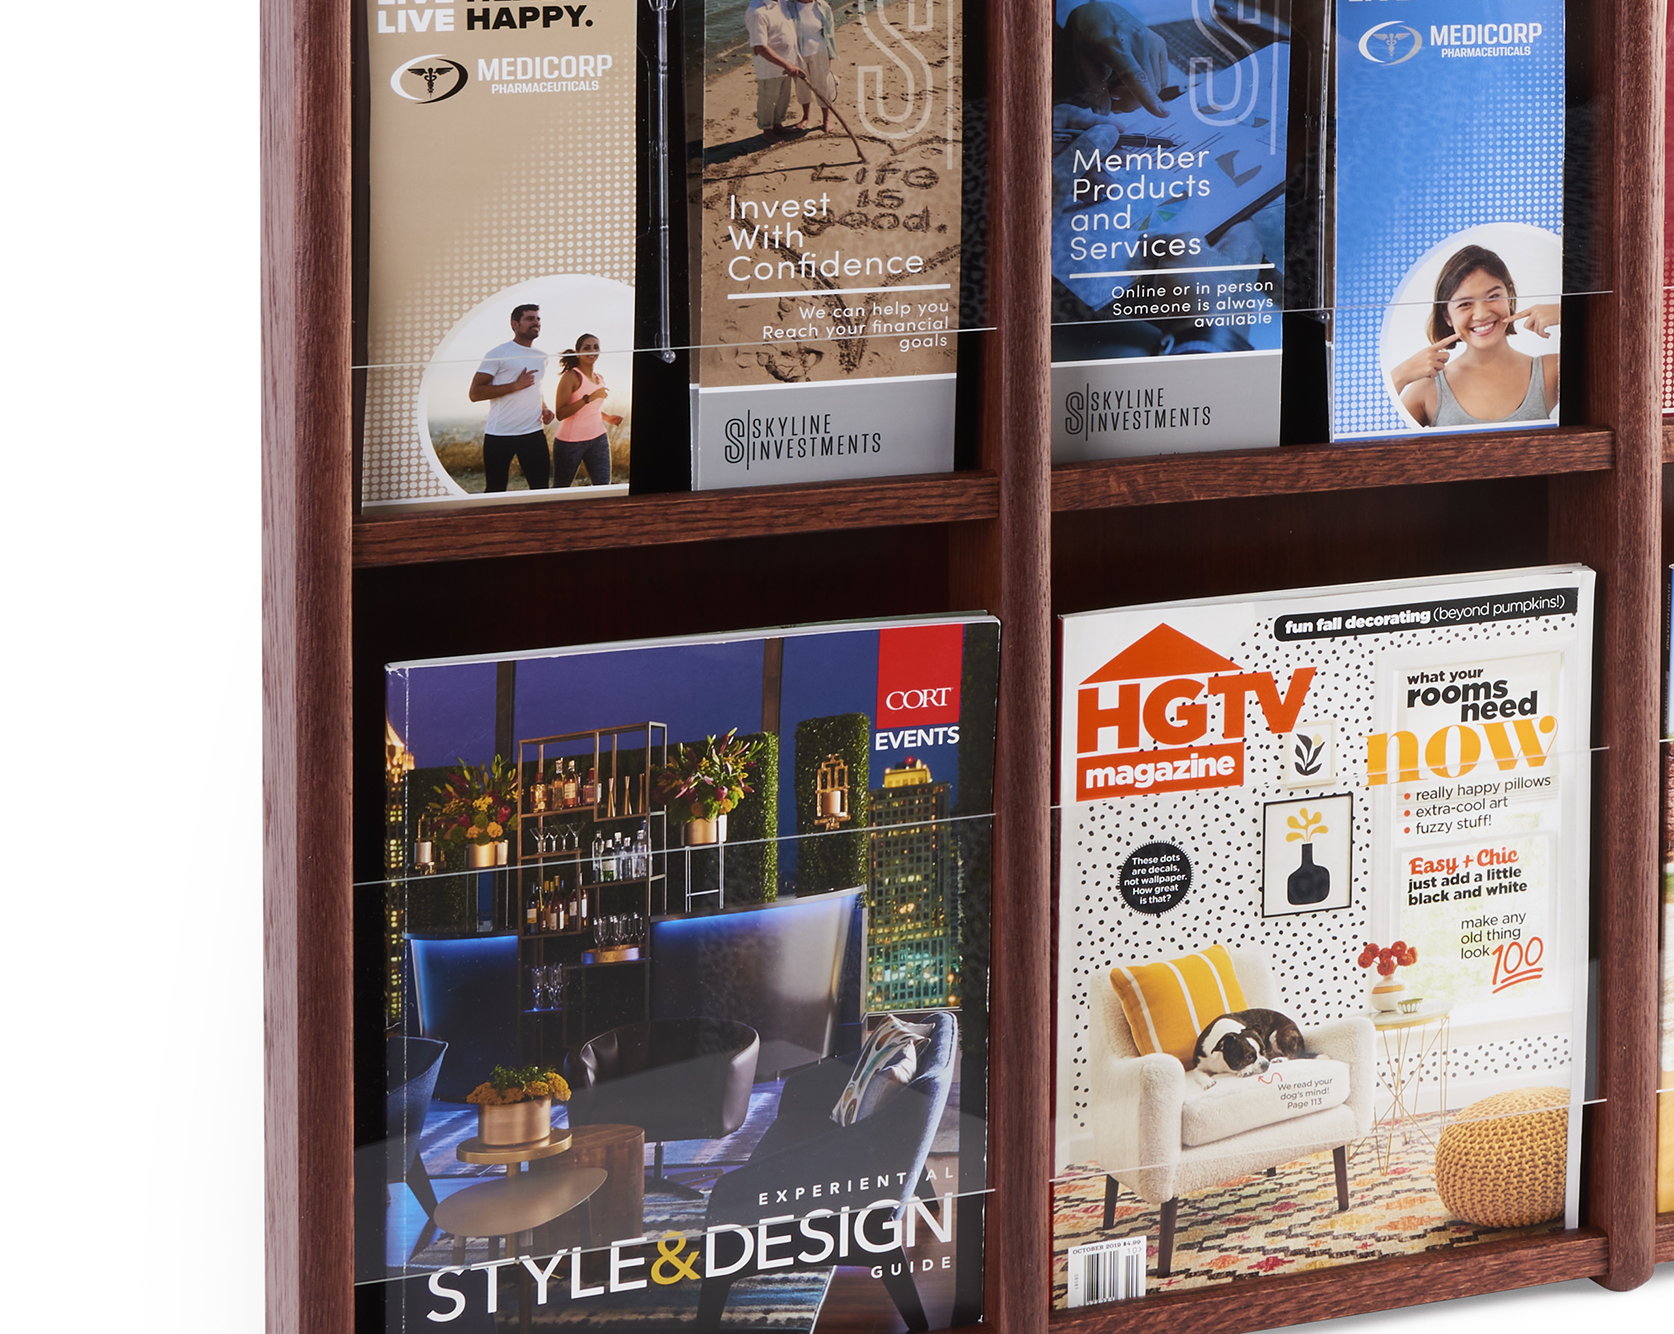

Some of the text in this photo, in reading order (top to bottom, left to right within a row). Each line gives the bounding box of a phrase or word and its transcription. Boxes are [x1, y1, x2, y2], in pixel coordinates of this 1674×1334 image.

[378, 5, 594, 33] LIVE HAPPY.
[1430, 22, 1542, 47] MEDICORP
[1441, 45, 1531, 58] PHARMACEUTICALS
[478, 55, 613, 81] MEDICORP
[491, 80, 600, 95] PHARMACEUTICALS
[1074, 146, 1209, 174] Member
[1072, 174, 1211, 203] Products
[729, 192, 831, 221] Invest
[1071, 204, 1132, 232] and
[729, 222, 804, 252] With
[1071, 234, 1201, 261] Services
[728, 251, 924, 283] Confidence
[1111, 280, 1274, 300] Online or in person
[799, 301, 950, 320] We can help you
[1112, 294, 1274, 316] Someone is always
[762, 315, 948, 340] Reach your financial
[1195, 312, 1272, 329] available
[900, 333, 948, 353] goals
[1091, 388, 1164, 411] SKYLINE
[752, 413, 832, 438] SKYLINE
[1090, 406, 1211, 433] INVESTMENTS
[751, 431, 882, 459] INVESTMENTS
[1285, 595, 1566, 635] fun fall decorating (beyond pumpkins!)
[1407, 669, 1483, 685] what your
[885, 687, 952, 711] CORT
[1407, 680, 1508, 708] rooms
[1461, 690, 1538, 722] need
[1077, 666, 1317, 754] HGTV
[875, 725, 960, 751] EVENTS
[1359, 715, 1558, 787] now
[1085, 753, 1235, 789] magazine
[1417, 777, 1551, 802] really happy pillows
[1416, 797, 1508, 818] extra-cool art
[1416, 815, 1492, 834] fuzzy stuff!
[1409, 857, 1459, 875] Easy
[1477, 847, 1519, 866] Chic
[1409, 881, 1527, 906] black and white
[1461, 913, 1526, 929] make any
[1461, 928, 1521, 944] old thing
[1461, 936, 1543, 985] look 100
[759, 1167, 954, 1205] EXPERIENTIAL
[870, 1256, 952, 1279] GUIDE
